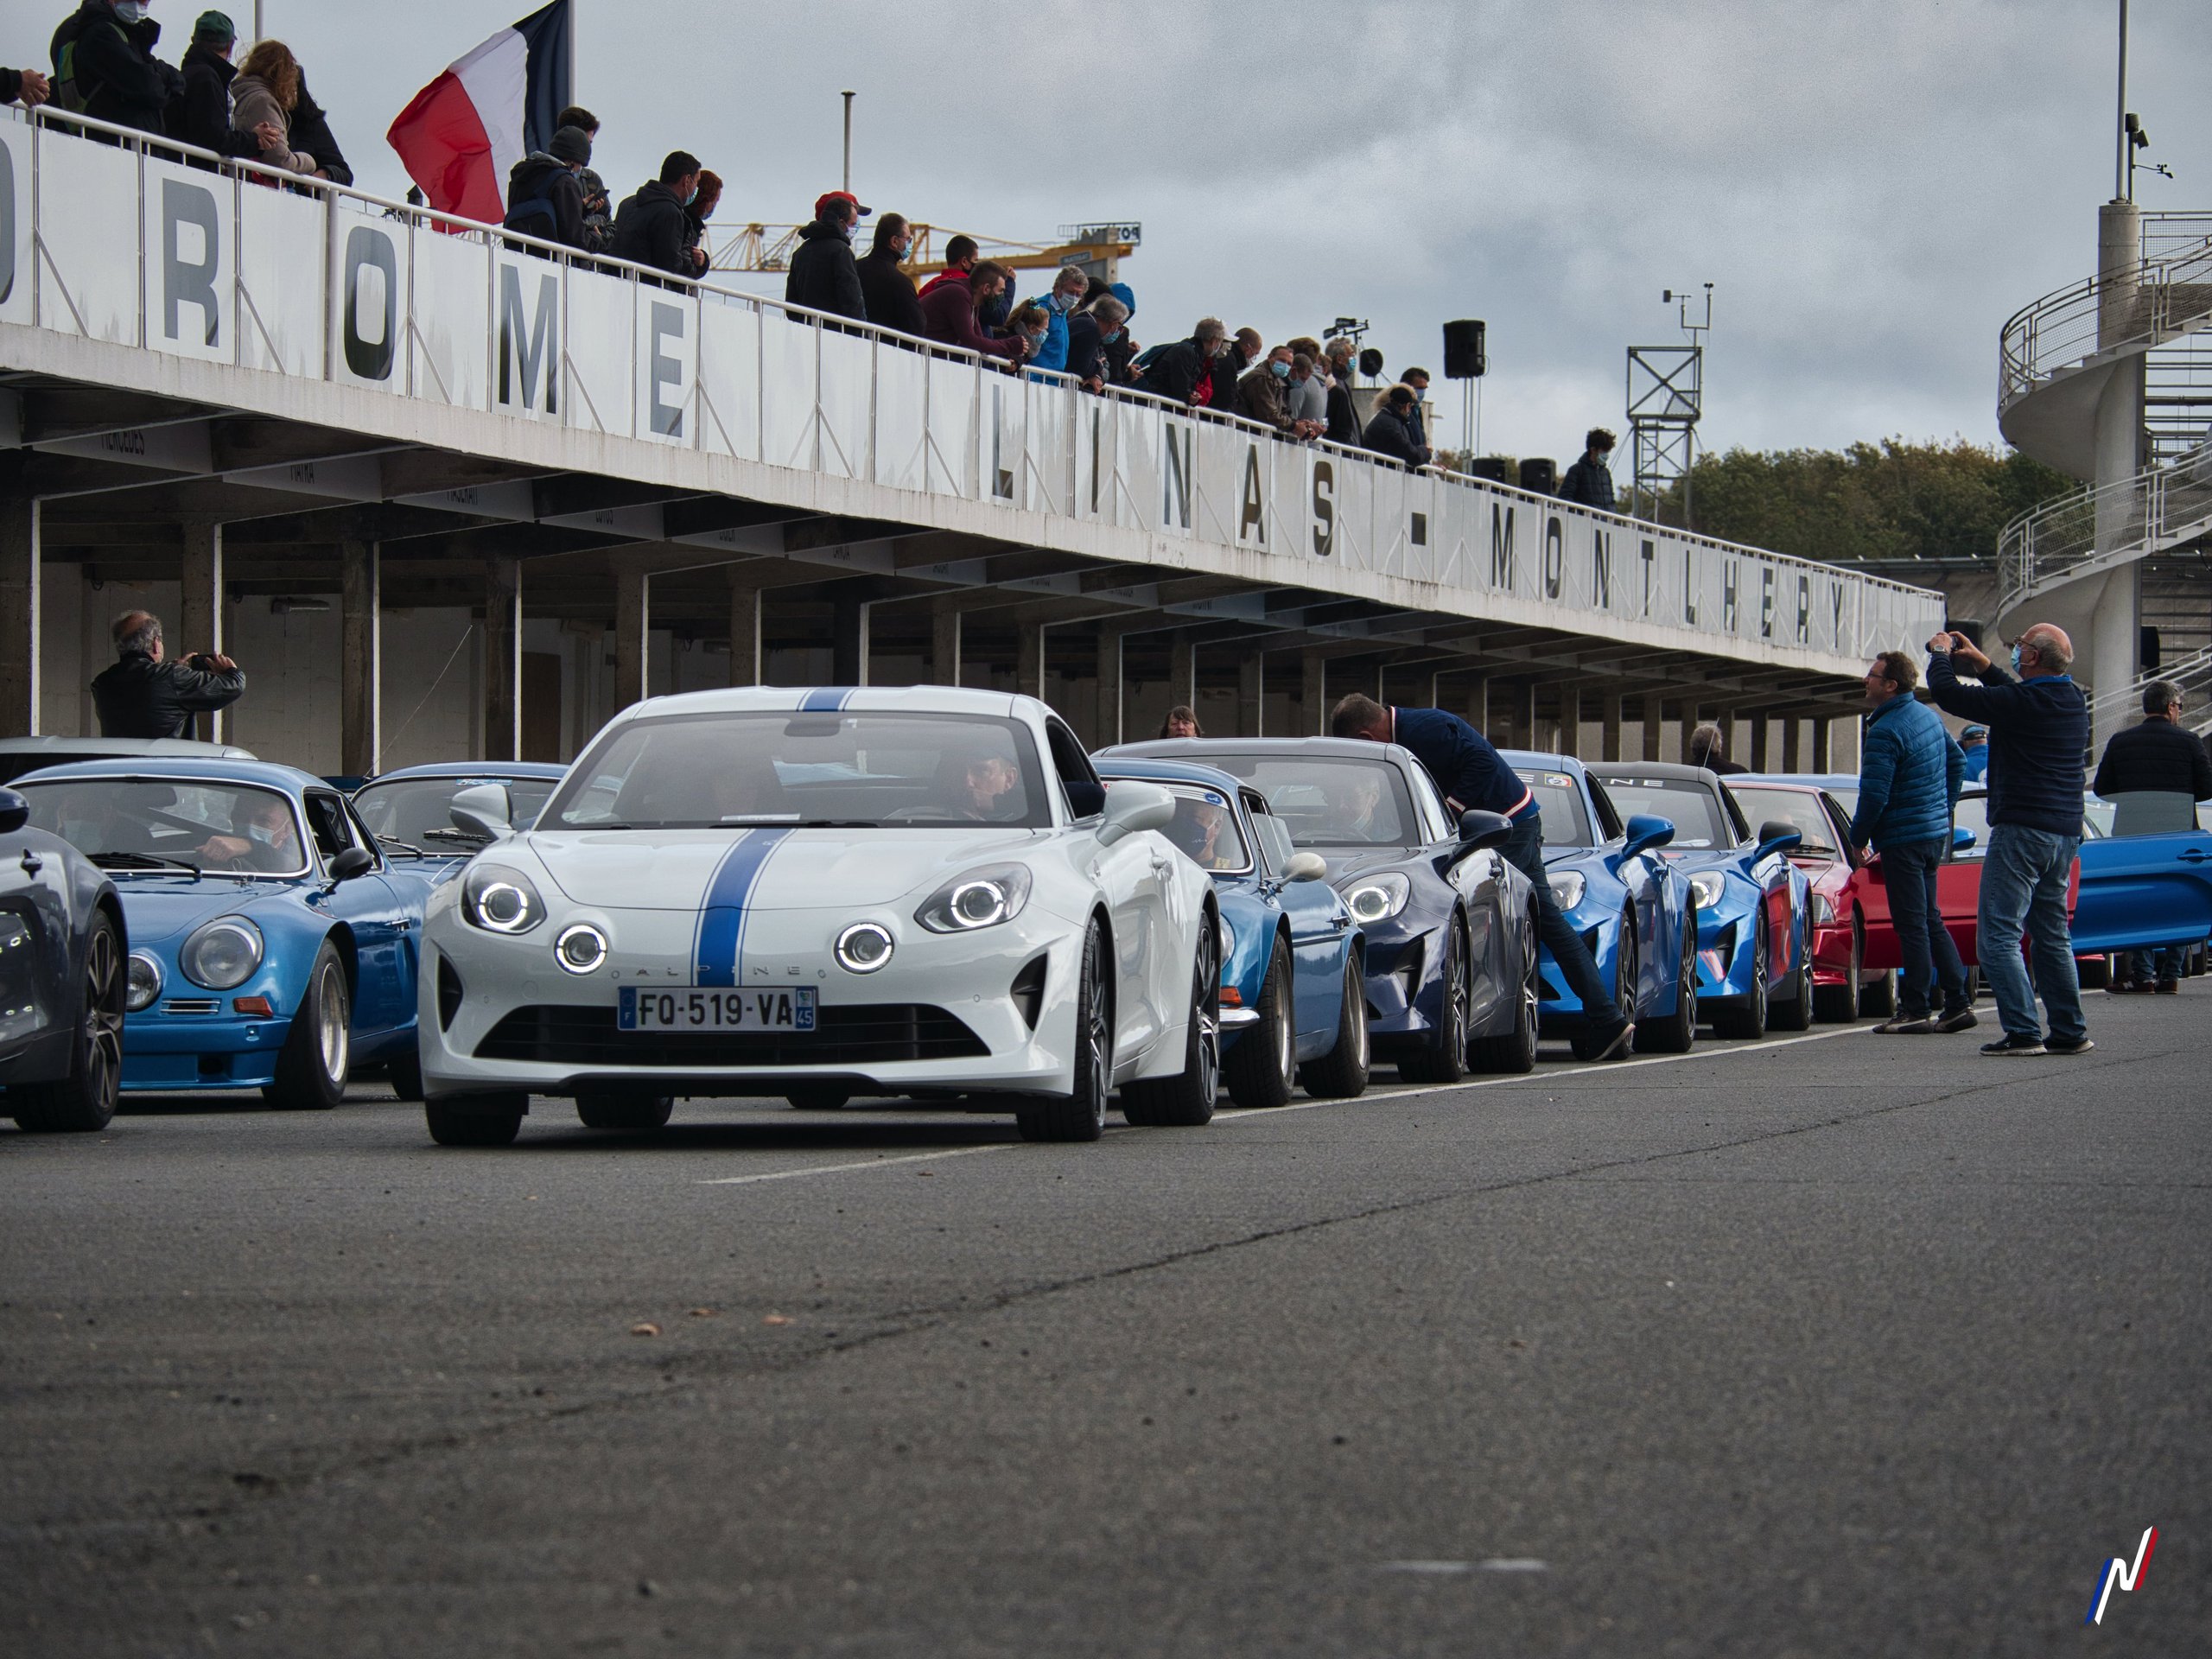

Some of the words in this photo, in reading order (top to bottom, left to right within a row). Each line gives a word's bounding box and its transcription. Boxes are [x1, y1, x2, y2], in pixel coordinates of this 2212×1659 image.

[0, 138, 684, 437] ROME
[993, 384, 1333, 556] LINAS
[1492, 502, 1842, 649] MONTLHERY
[625, 1012, 631, 1021] F
[639, 994, 792, 1026] FQ-519-VA
[798, 1010, 812, 1025] 45
